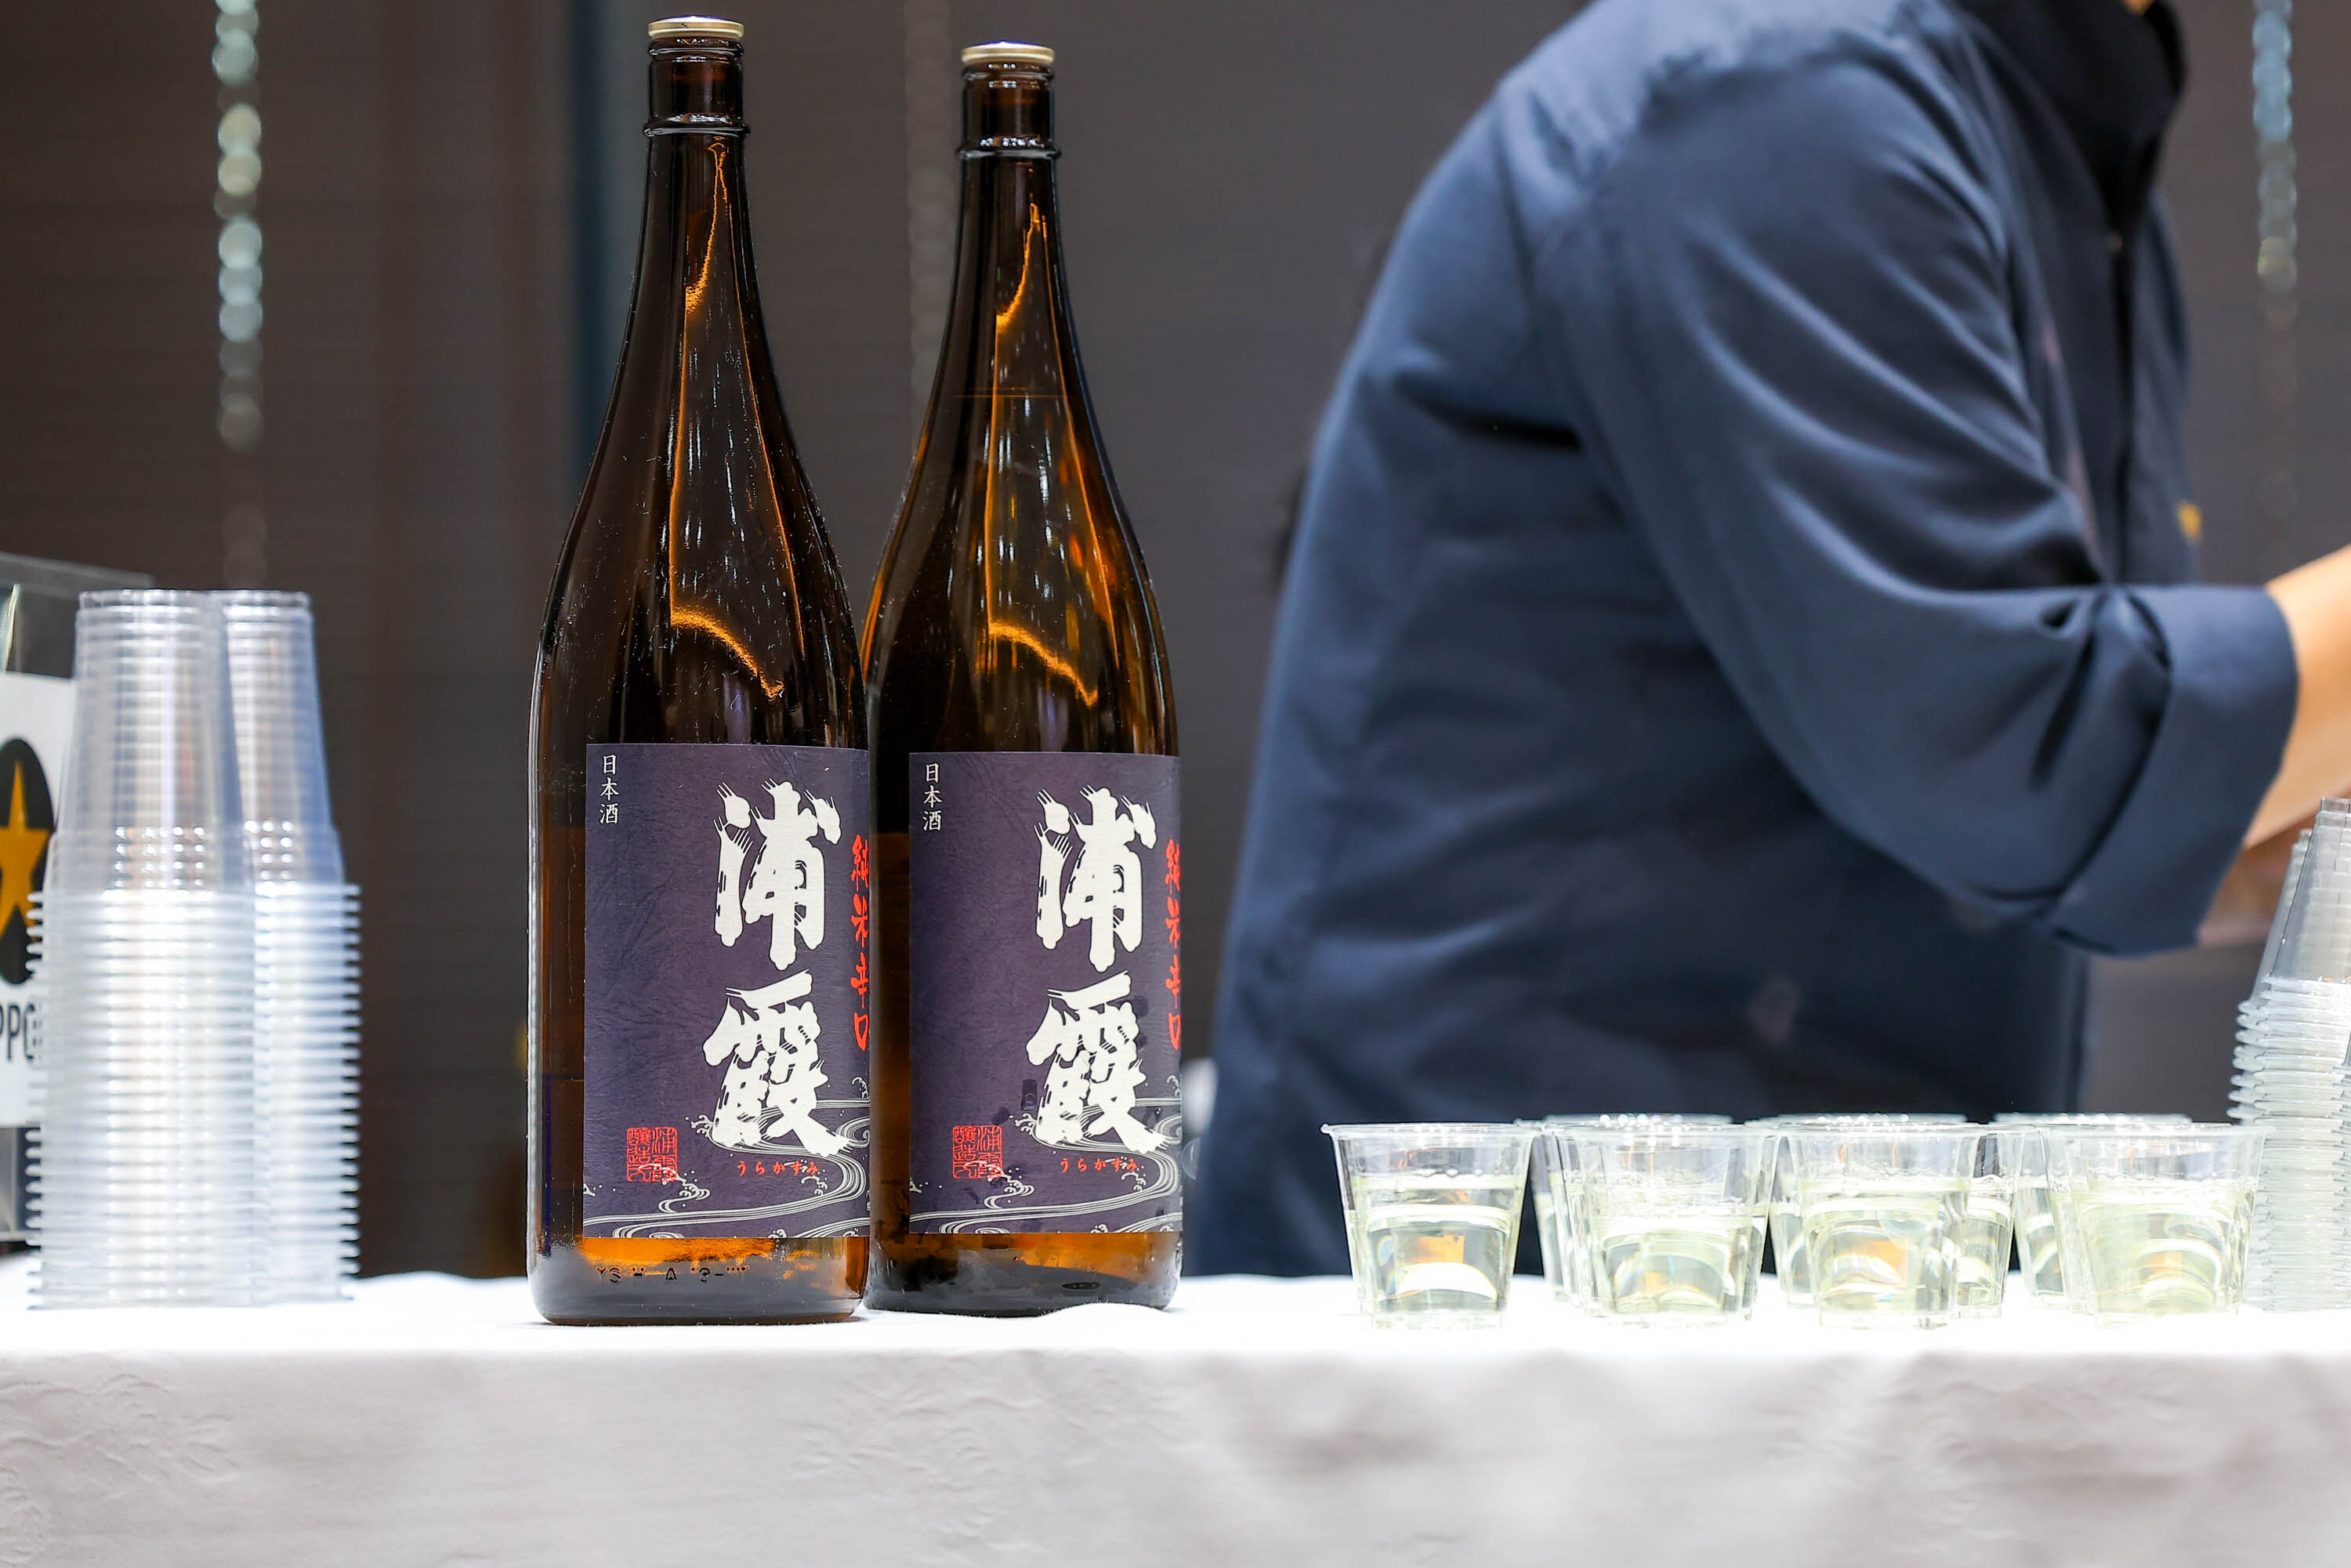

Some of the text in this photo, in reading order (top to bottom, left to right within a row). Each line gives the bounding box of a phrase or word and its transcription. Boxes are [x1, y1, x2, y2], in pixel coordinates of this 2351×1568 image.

[599, 754, 620, 824] 日本酒
[922, 762, 943, 831] 日本酒
[703, 777, 853, 1157] 浦霞
[1026, 784, 1168, 1154] 浦霞
[737, 1161, 818, 1177] うらかすみ
[1060, 1157, 1138, 1173] うらかすみ
